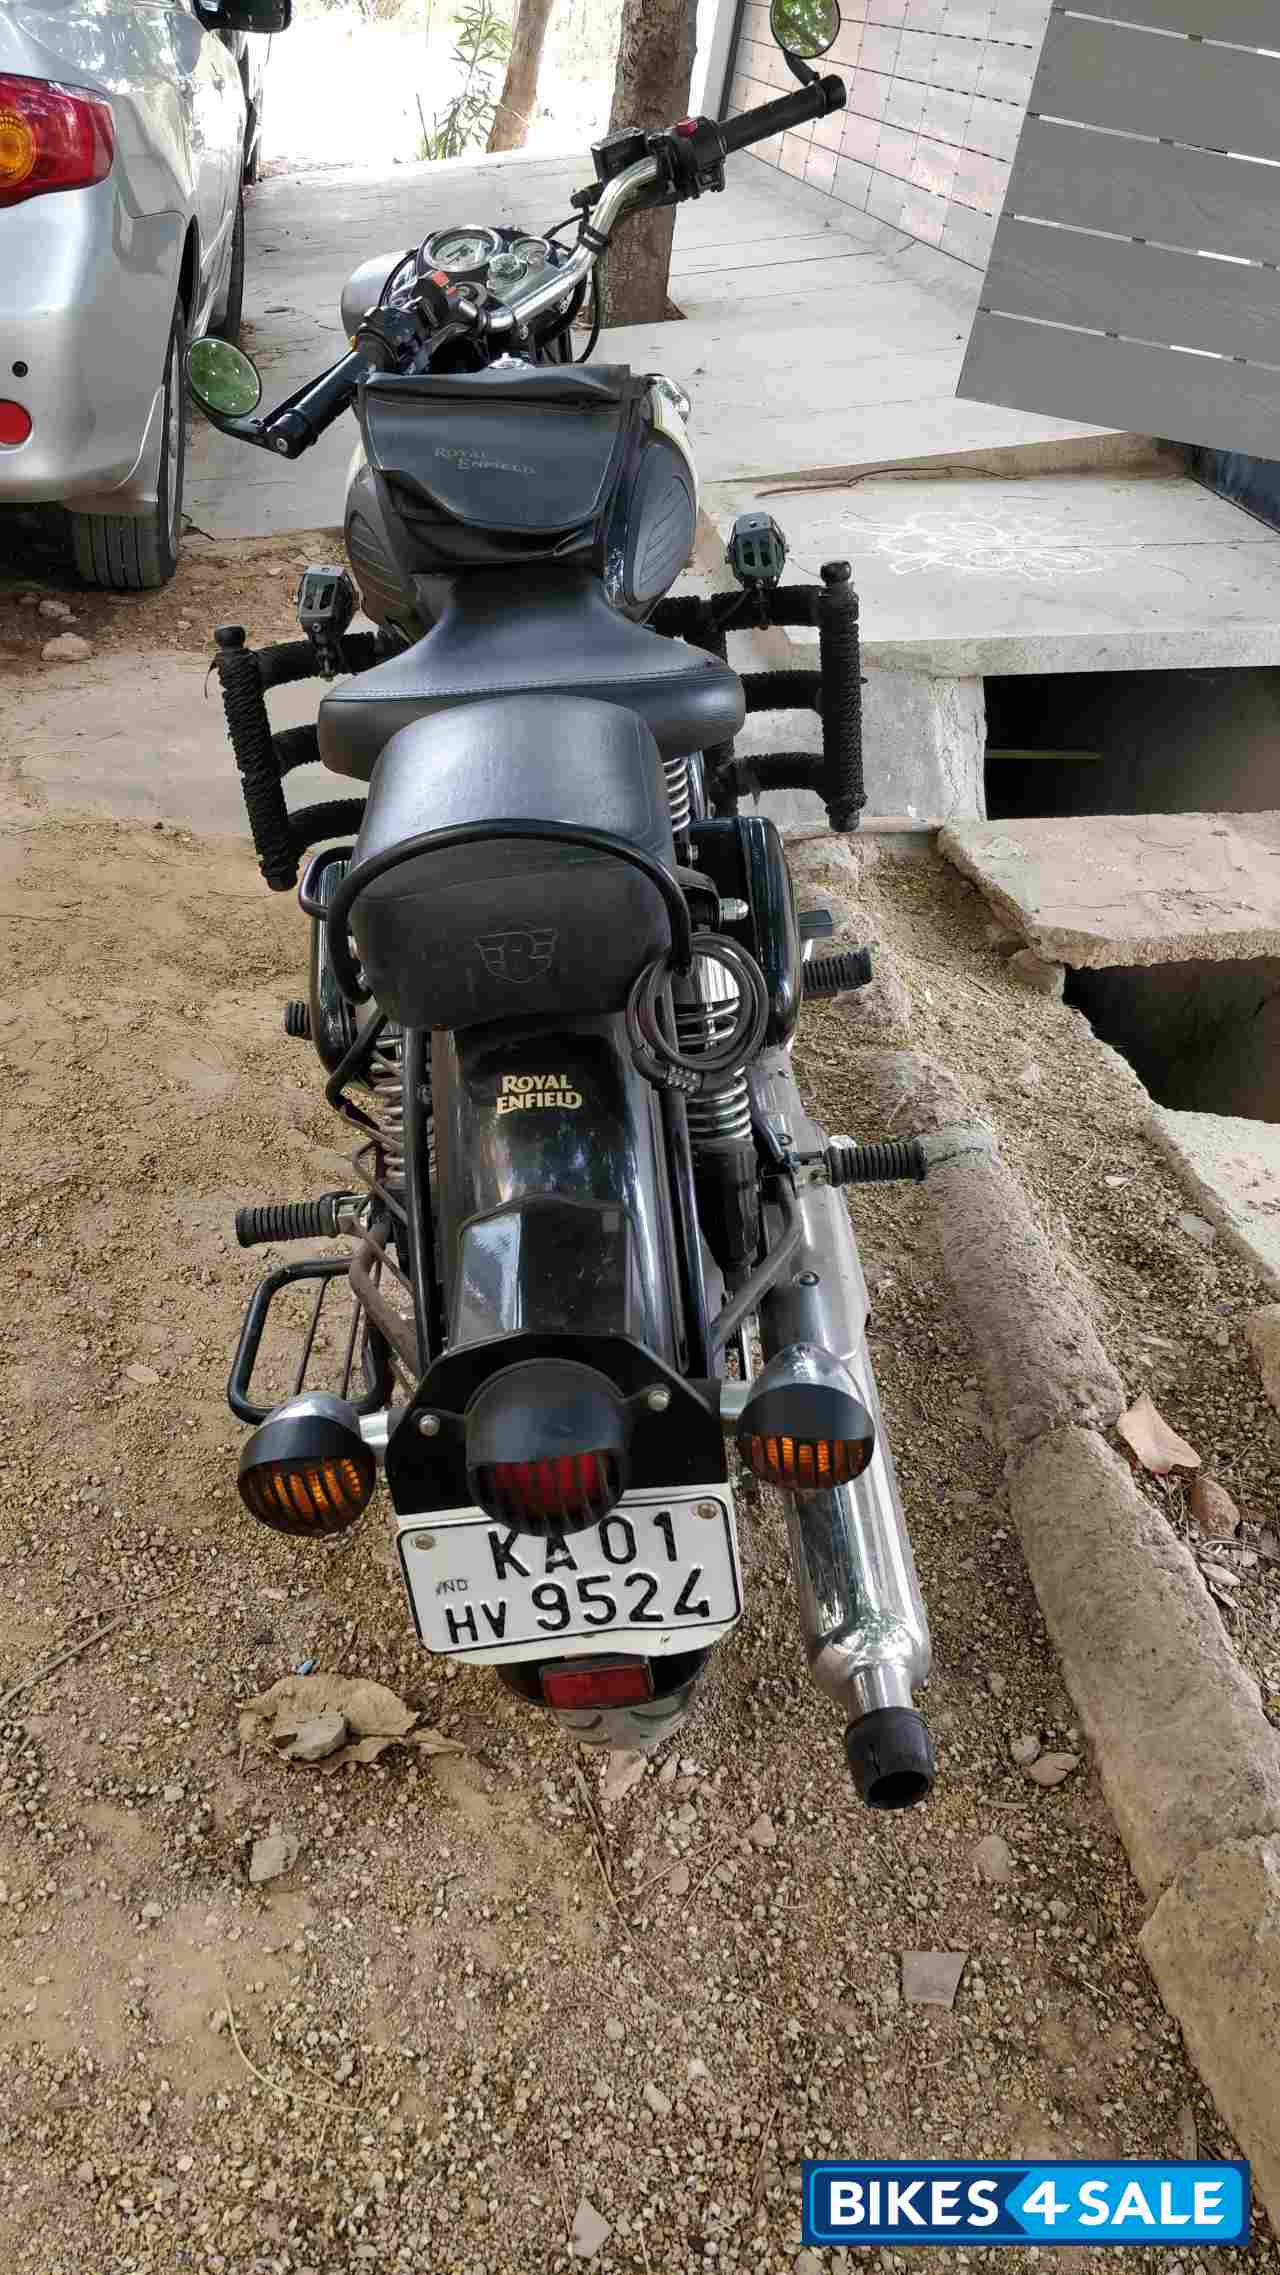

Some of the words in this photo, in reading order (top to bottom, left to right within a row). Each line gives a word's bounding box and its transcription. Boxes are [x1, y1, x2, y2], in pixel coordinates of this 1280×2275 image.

[501, 1074, 573, 1093] ROYAL
[496, 1091, 582, 1114] ENFIELD
[488, 1530, 578, 1580] KA
[598, 1511, 679, 1564] 01
[436, 1579, 469, 1595] IND
[445, 1601, 507, 1643] HV
[531, 1568, 711, 1631] 9524
